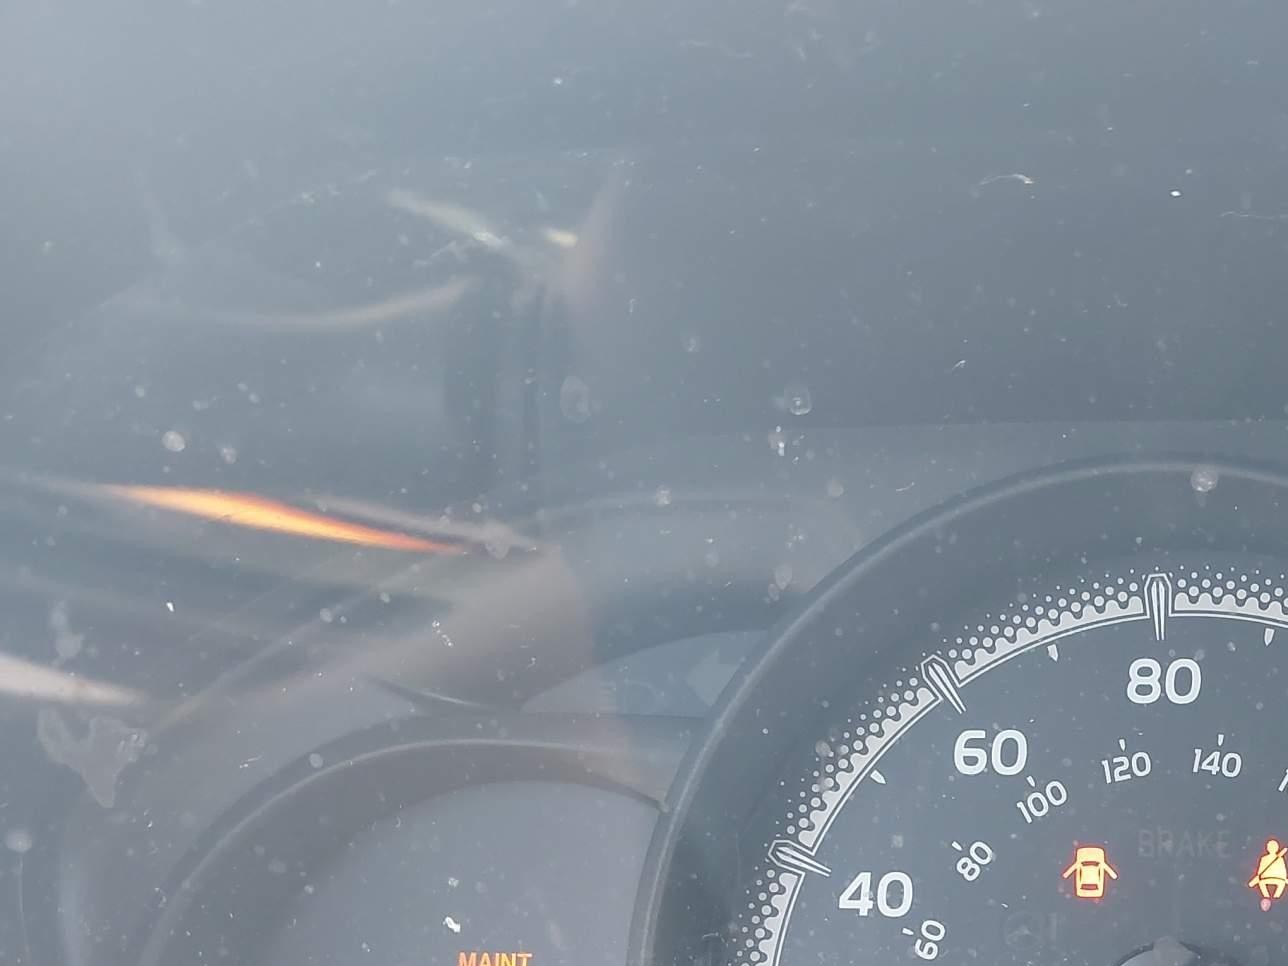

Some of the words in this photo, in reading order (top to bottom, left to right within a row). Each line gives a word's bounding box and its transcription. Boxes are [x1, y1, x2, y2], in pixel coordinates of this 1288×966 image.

[1126, 658, 1201, 703] 80
[953, 730, 1028, 775] 60
[1102, 751, 1152, 784] 120
[1192, 748, 1242, 778] 140
[1017, 780, 1068, 823] 100
[956, 840, 993, 881] 80
[838, 871, 913, 917] 40
[914, 919, 946, 960] 60
